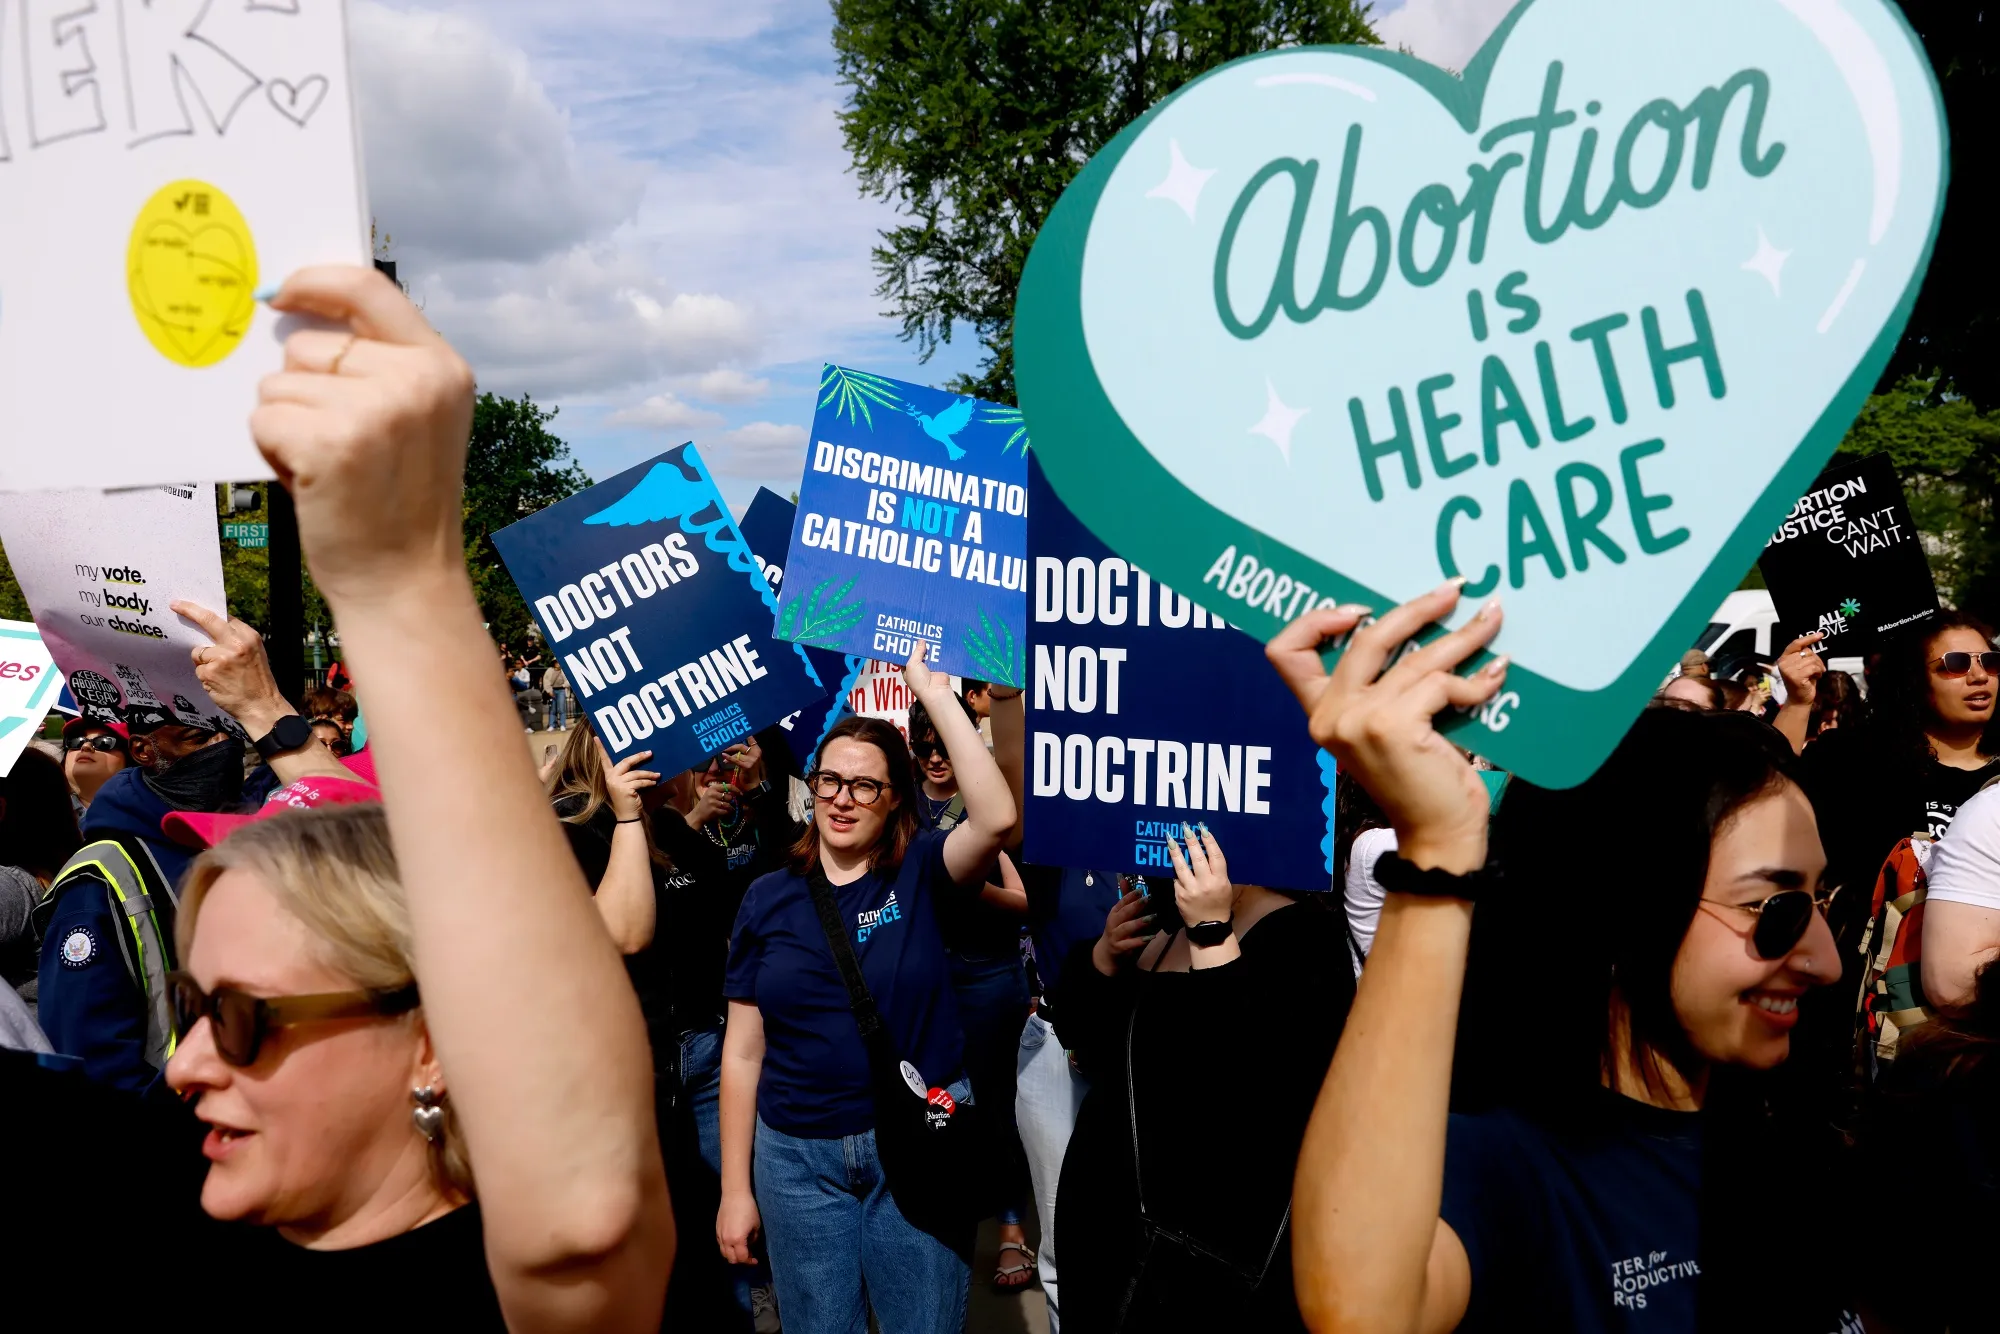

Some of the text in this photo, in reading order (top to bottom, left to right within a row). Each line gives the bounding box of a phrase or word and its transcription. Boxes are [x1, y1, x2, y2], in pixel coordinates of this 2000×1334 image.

[1213, 59, 1785, 340] Abortion
[1347, 289, 1727, 502] HEALTH
[813, 440, 1028, 518] DISCRIMINATIO
[225, 525, 268, 537] FIRST
[866, 488, 983, 544] IS NOT A
[1435, 437, 1691, 600] CARE
[1764, 504, 1847, 548] USTICE
[1826, 506, 1895, 544] CAN'T
[239, 537, 265, 547] UNIT
[801, 512, 1027, 592] CATHOLIC VALU
[1843, 525, 1911, 559] WAIT.
[75, 564, 146, 583] my vote.
[534, 532, 700, 643] DOCTORS
[79, 588, 153, 616] my body.
[1035, 556, 1244, 630] DOCTO
[80, 614, 168, 639] our choice.
[877, 613, 943, 639] CATHOLICS
[1819, 610, 1845, 628] ALL
[563, 625, 644, 699] NOT
[1811, 641, 1828, 654] LL
[0, 660, 41, 682] es
[72, 678, 118, 694] ABORTION
[1034, 644, 1127, 715] NOT
[78, 689, 118, 703] LEGAL
[593, 633, 768, 754] DOCTRINE
[692, 702, 742, 735] CATHOLICS
[700, 716, 752, 753] CHOICE
[1033, 731, 1272, 815] DOCTRINE
[1648, 1250, 1667, 1269] for
